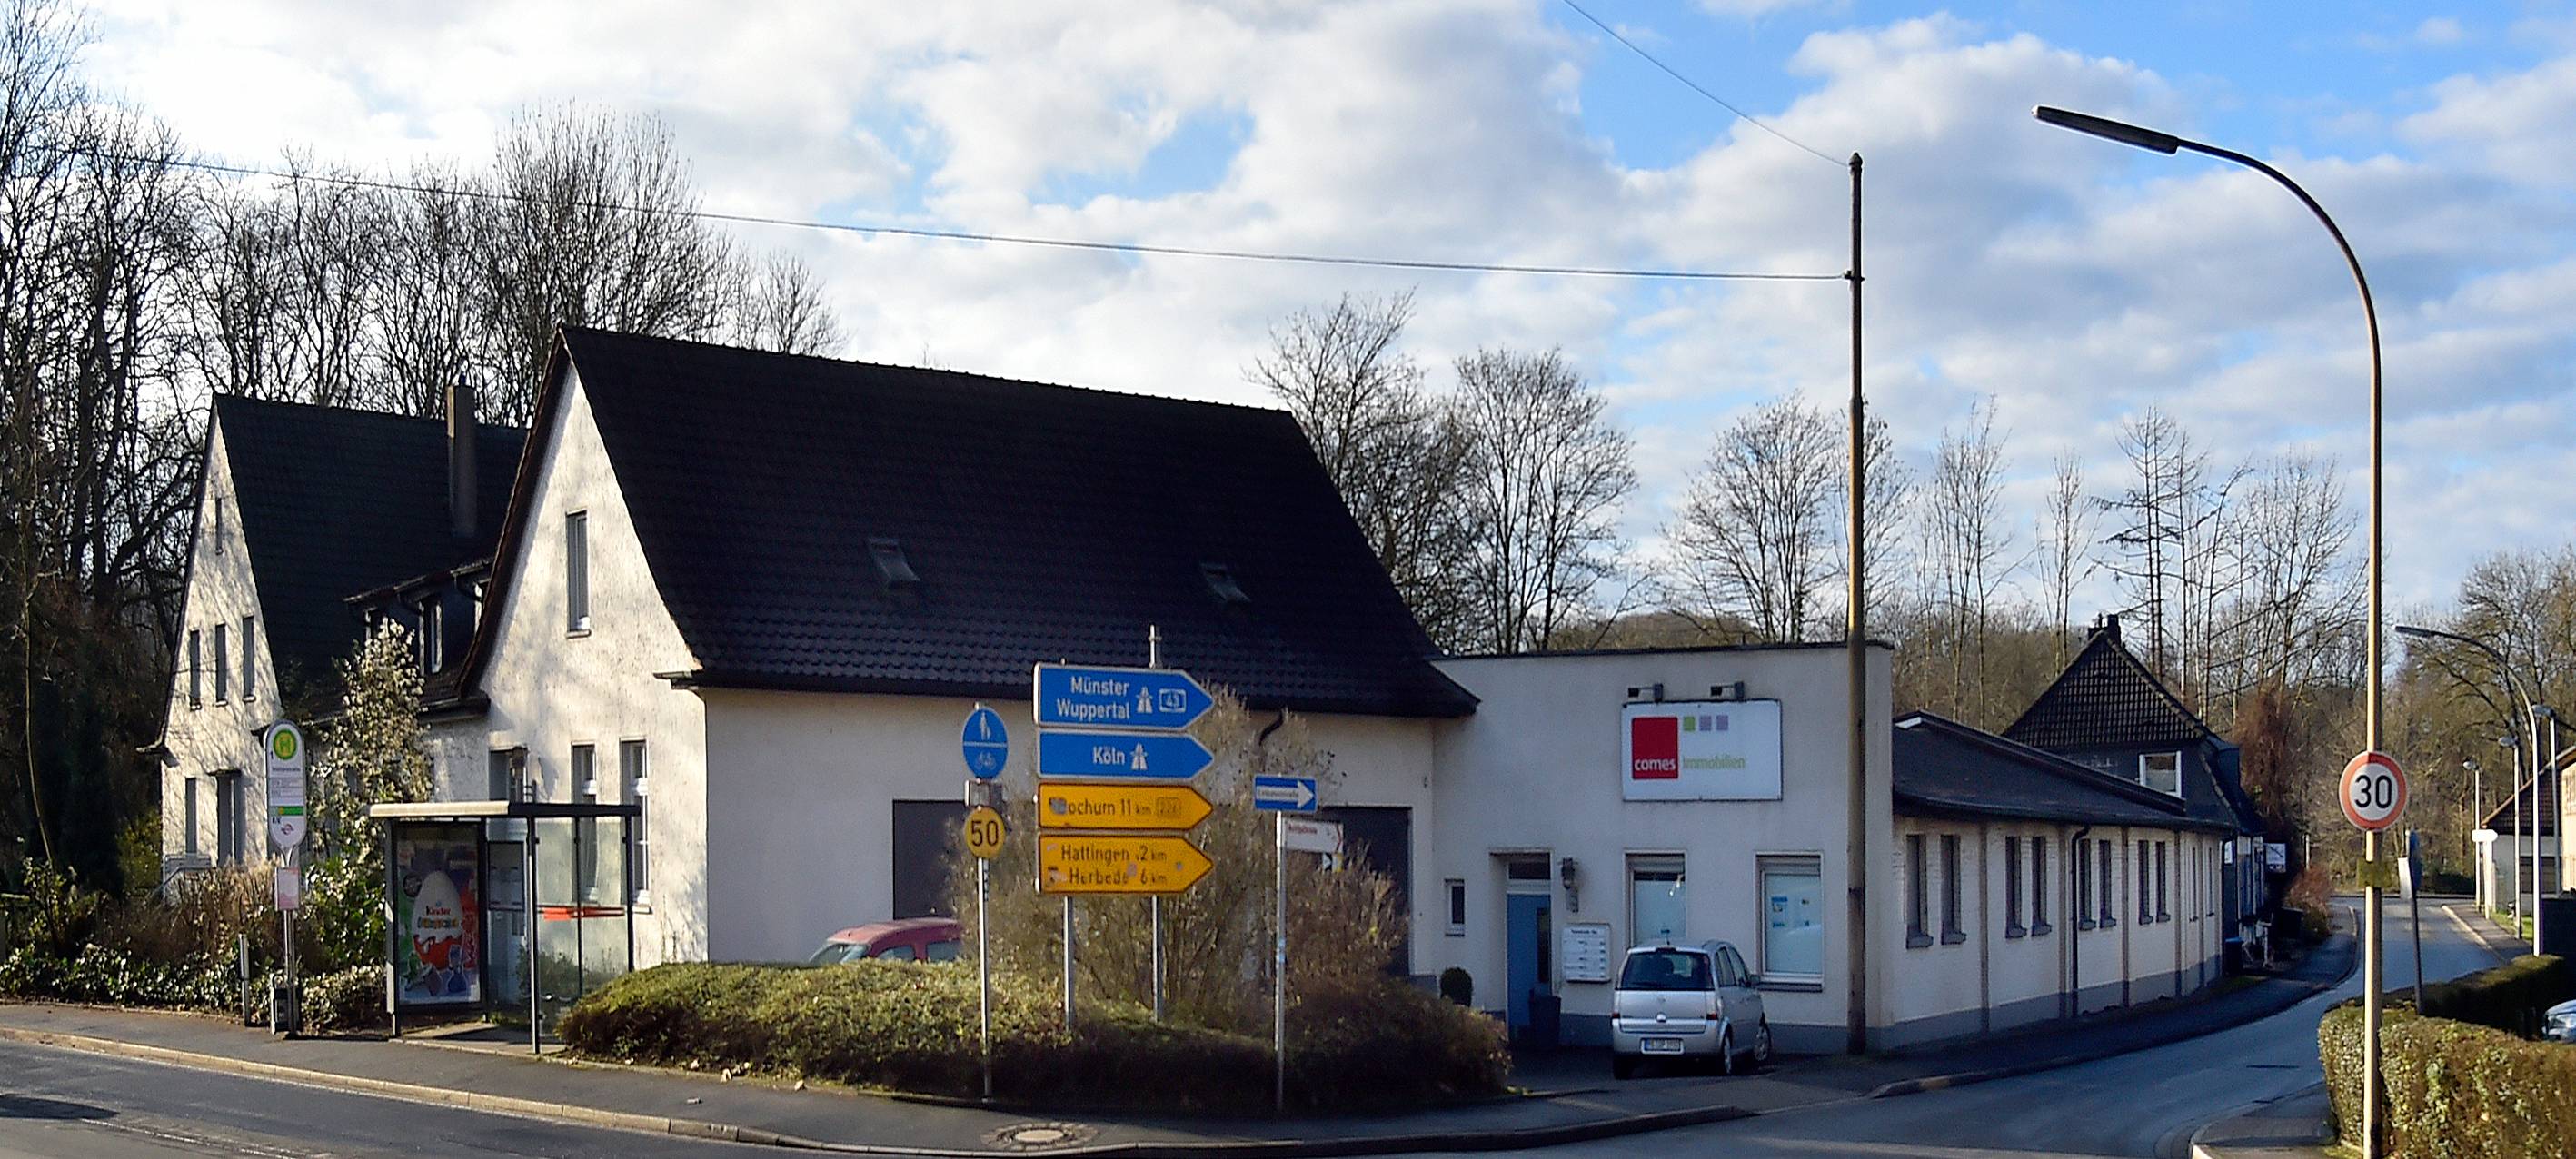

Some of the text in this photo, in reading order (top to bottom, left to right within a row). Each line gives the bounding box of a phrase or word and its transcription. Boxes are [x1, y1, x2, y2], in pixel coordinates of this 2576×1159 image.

[1070, 676, 1129, 697] Münster
[1056, 698, 1130, 721] Wuppertal
[1092, 746, 1126, 766] Köln
[1634, 757, 1676, 772] comes
[2354, 774, 2392, 809] 30
[1049, 797, 1116, 816] ochum
[1120, 798, 1132, 816] 11
[1136, 803, 1152, 815] km
[970, 820, 1000, 847] 50
[1060, 843, 1130, 866] Hattingen
[1150, 848, 1168, 862] km
[1069, 867, 1168, 886] Herbede 6 km
